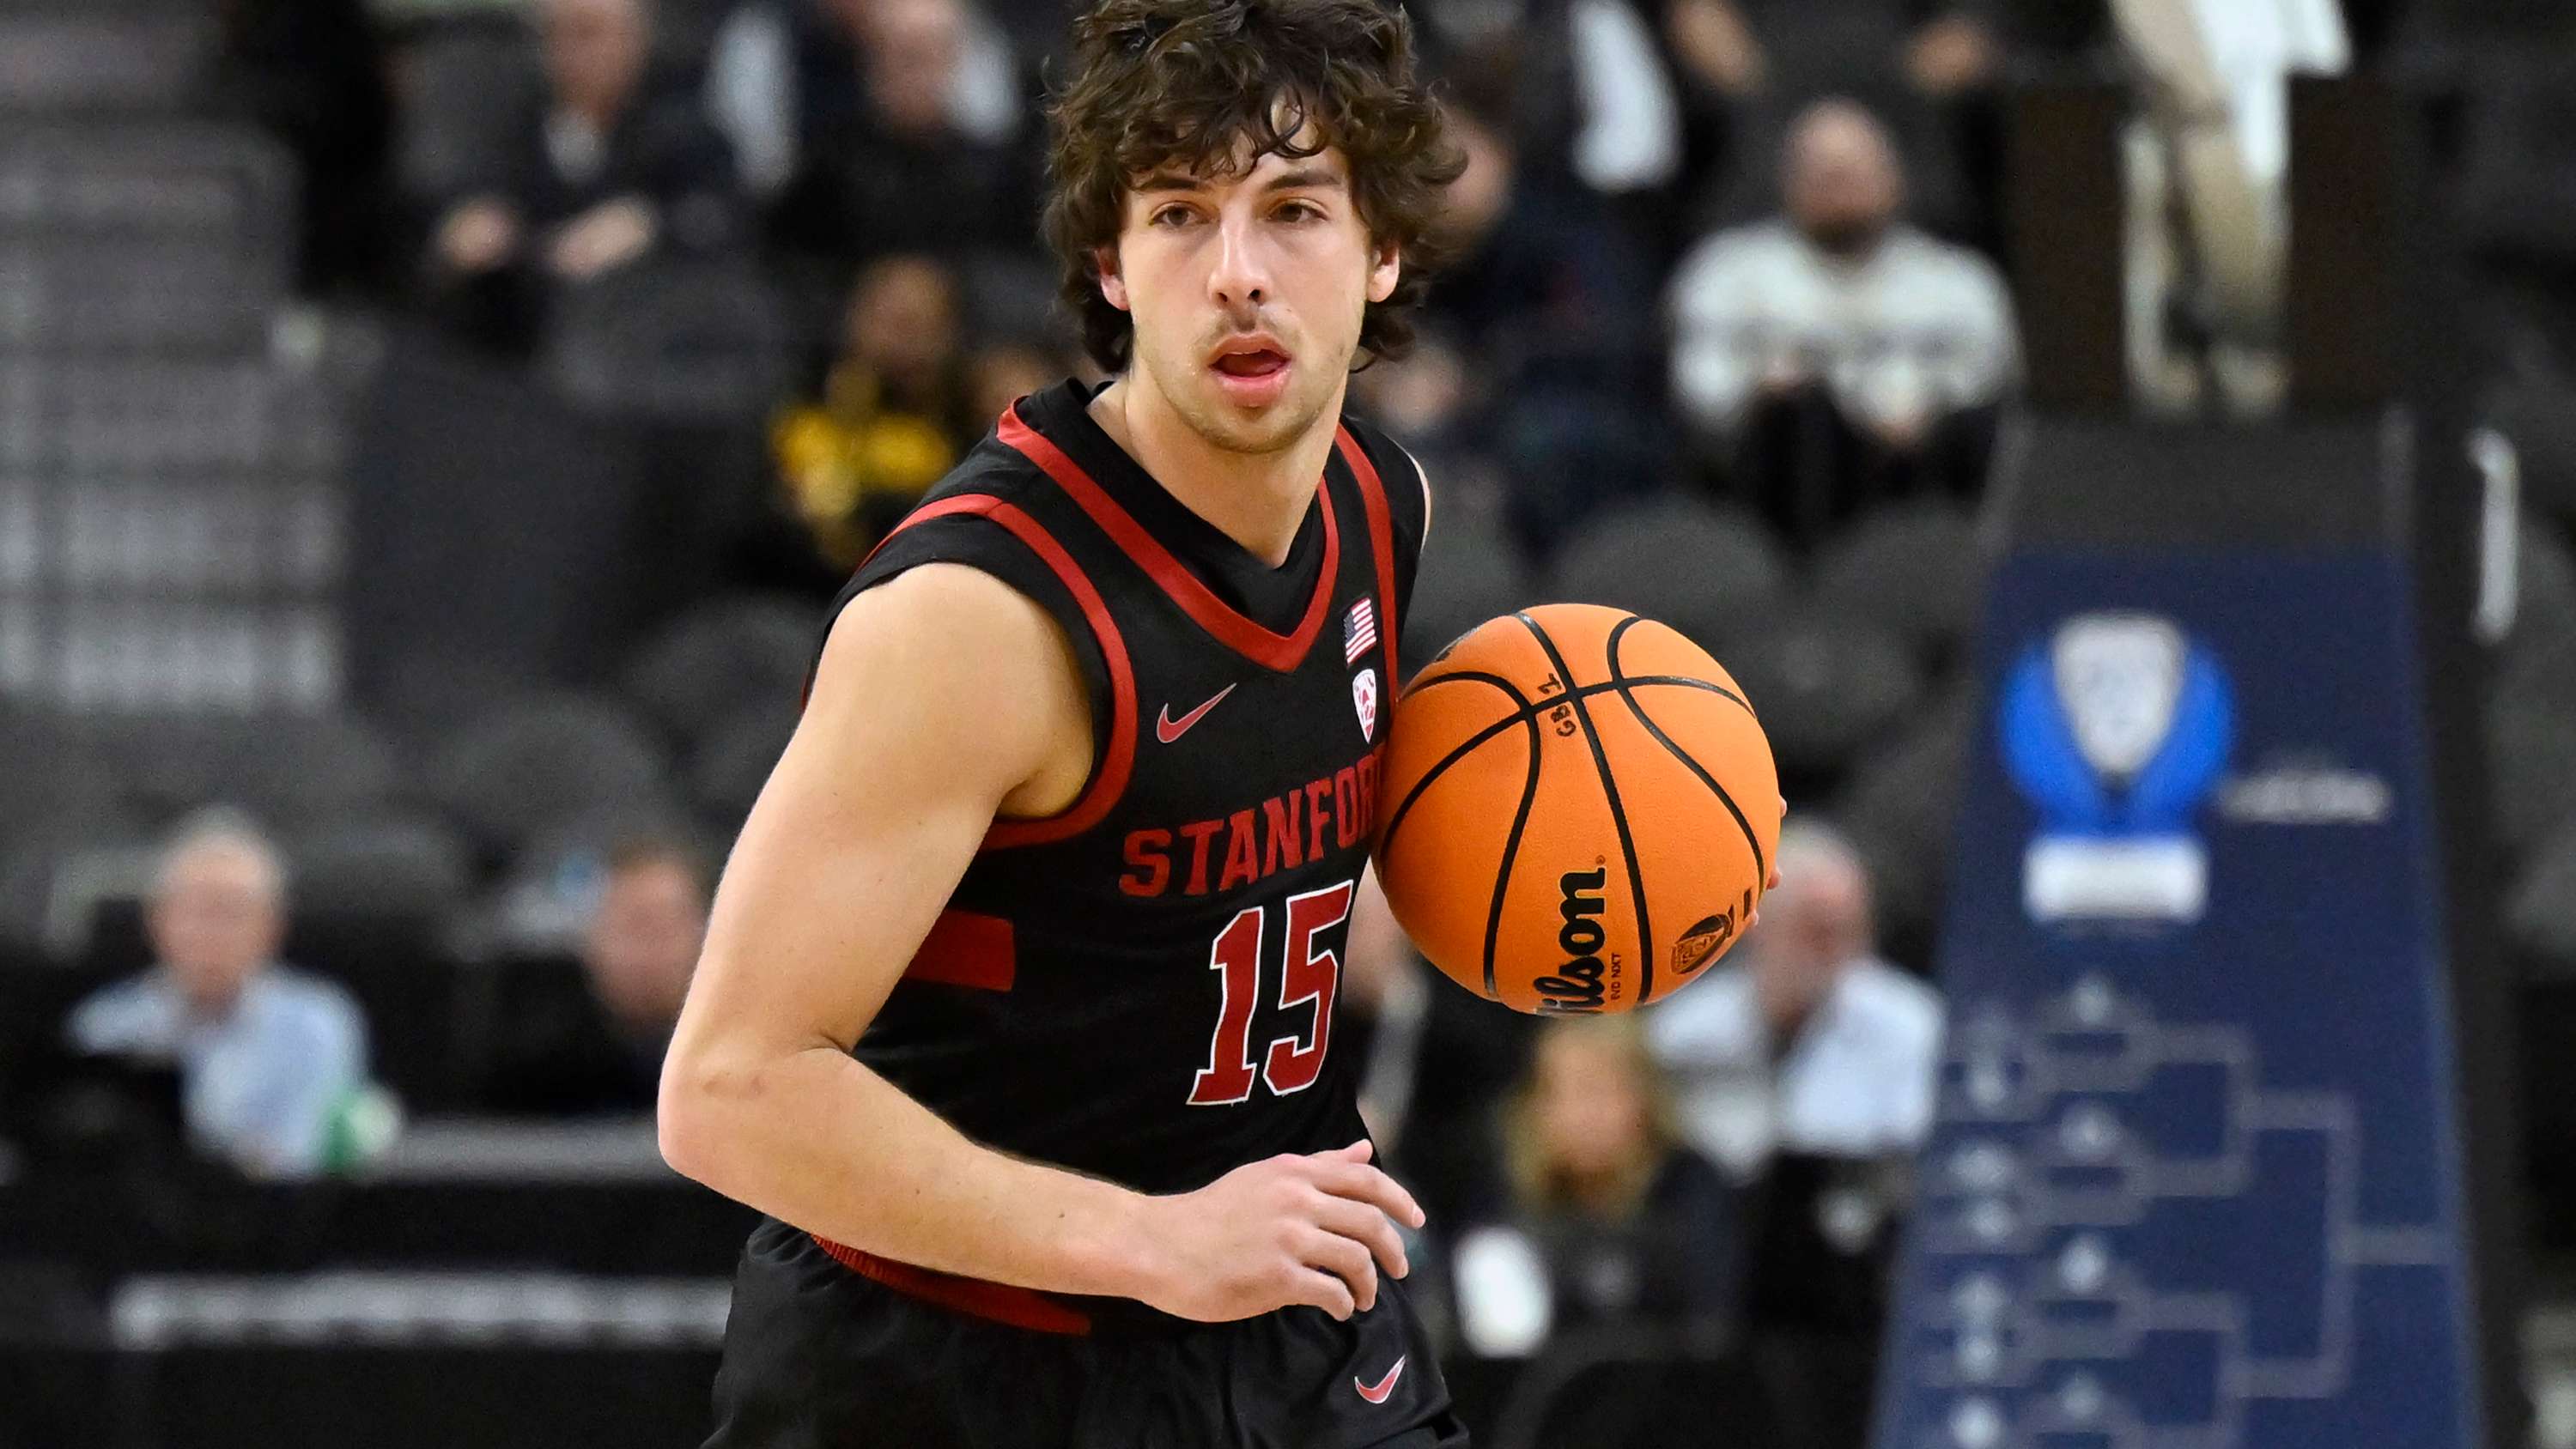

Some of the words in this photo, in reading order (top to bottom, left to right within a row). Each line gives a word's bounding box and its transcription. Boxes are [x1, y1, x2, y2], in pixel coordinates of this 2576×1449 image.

[1118, 743, 1383, 897] STANFOR
[1186, 879, 1354, 1106] 15
[1533, 866, 1606, 1015] ilson
[1611, 953, 1621, 979] NXT
